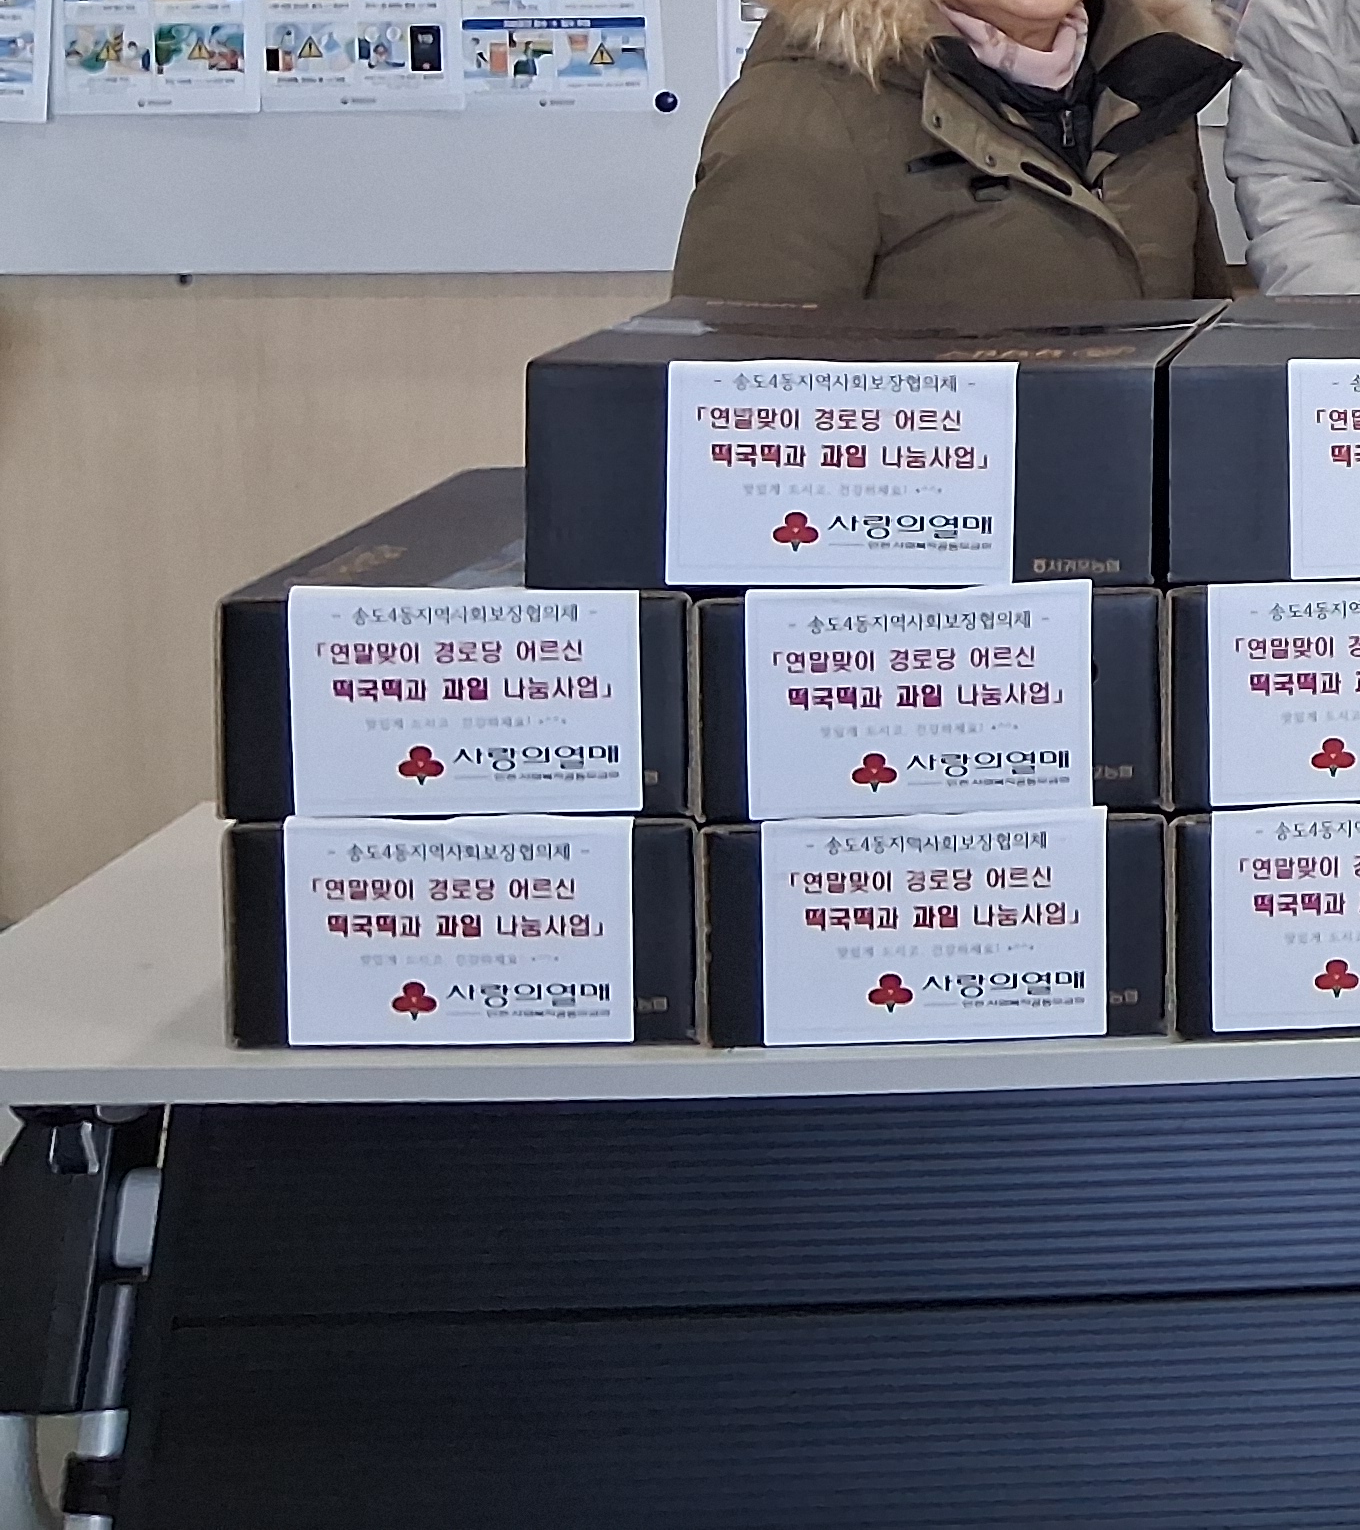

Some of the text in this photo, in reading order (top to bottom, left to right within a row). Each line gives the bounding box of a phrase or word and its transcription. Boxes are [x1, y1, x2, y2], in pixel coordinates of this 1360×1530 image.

[815, 407, 881, 431] 경로당
[895, 409, 962, 431] 어르신
[712, 444, 988, 470] 떡국떡과 과일 나눔사업」
[829, 513, 994, 539] 사랑의열매
[429, 878, 494, 901] 경로당
[509, 878, 576, 900] 어르신
[327, 914, 604, 937] 떡국떡과 과일 나눔사업」
[447, 983, 610, 1008] 사랑의열매
